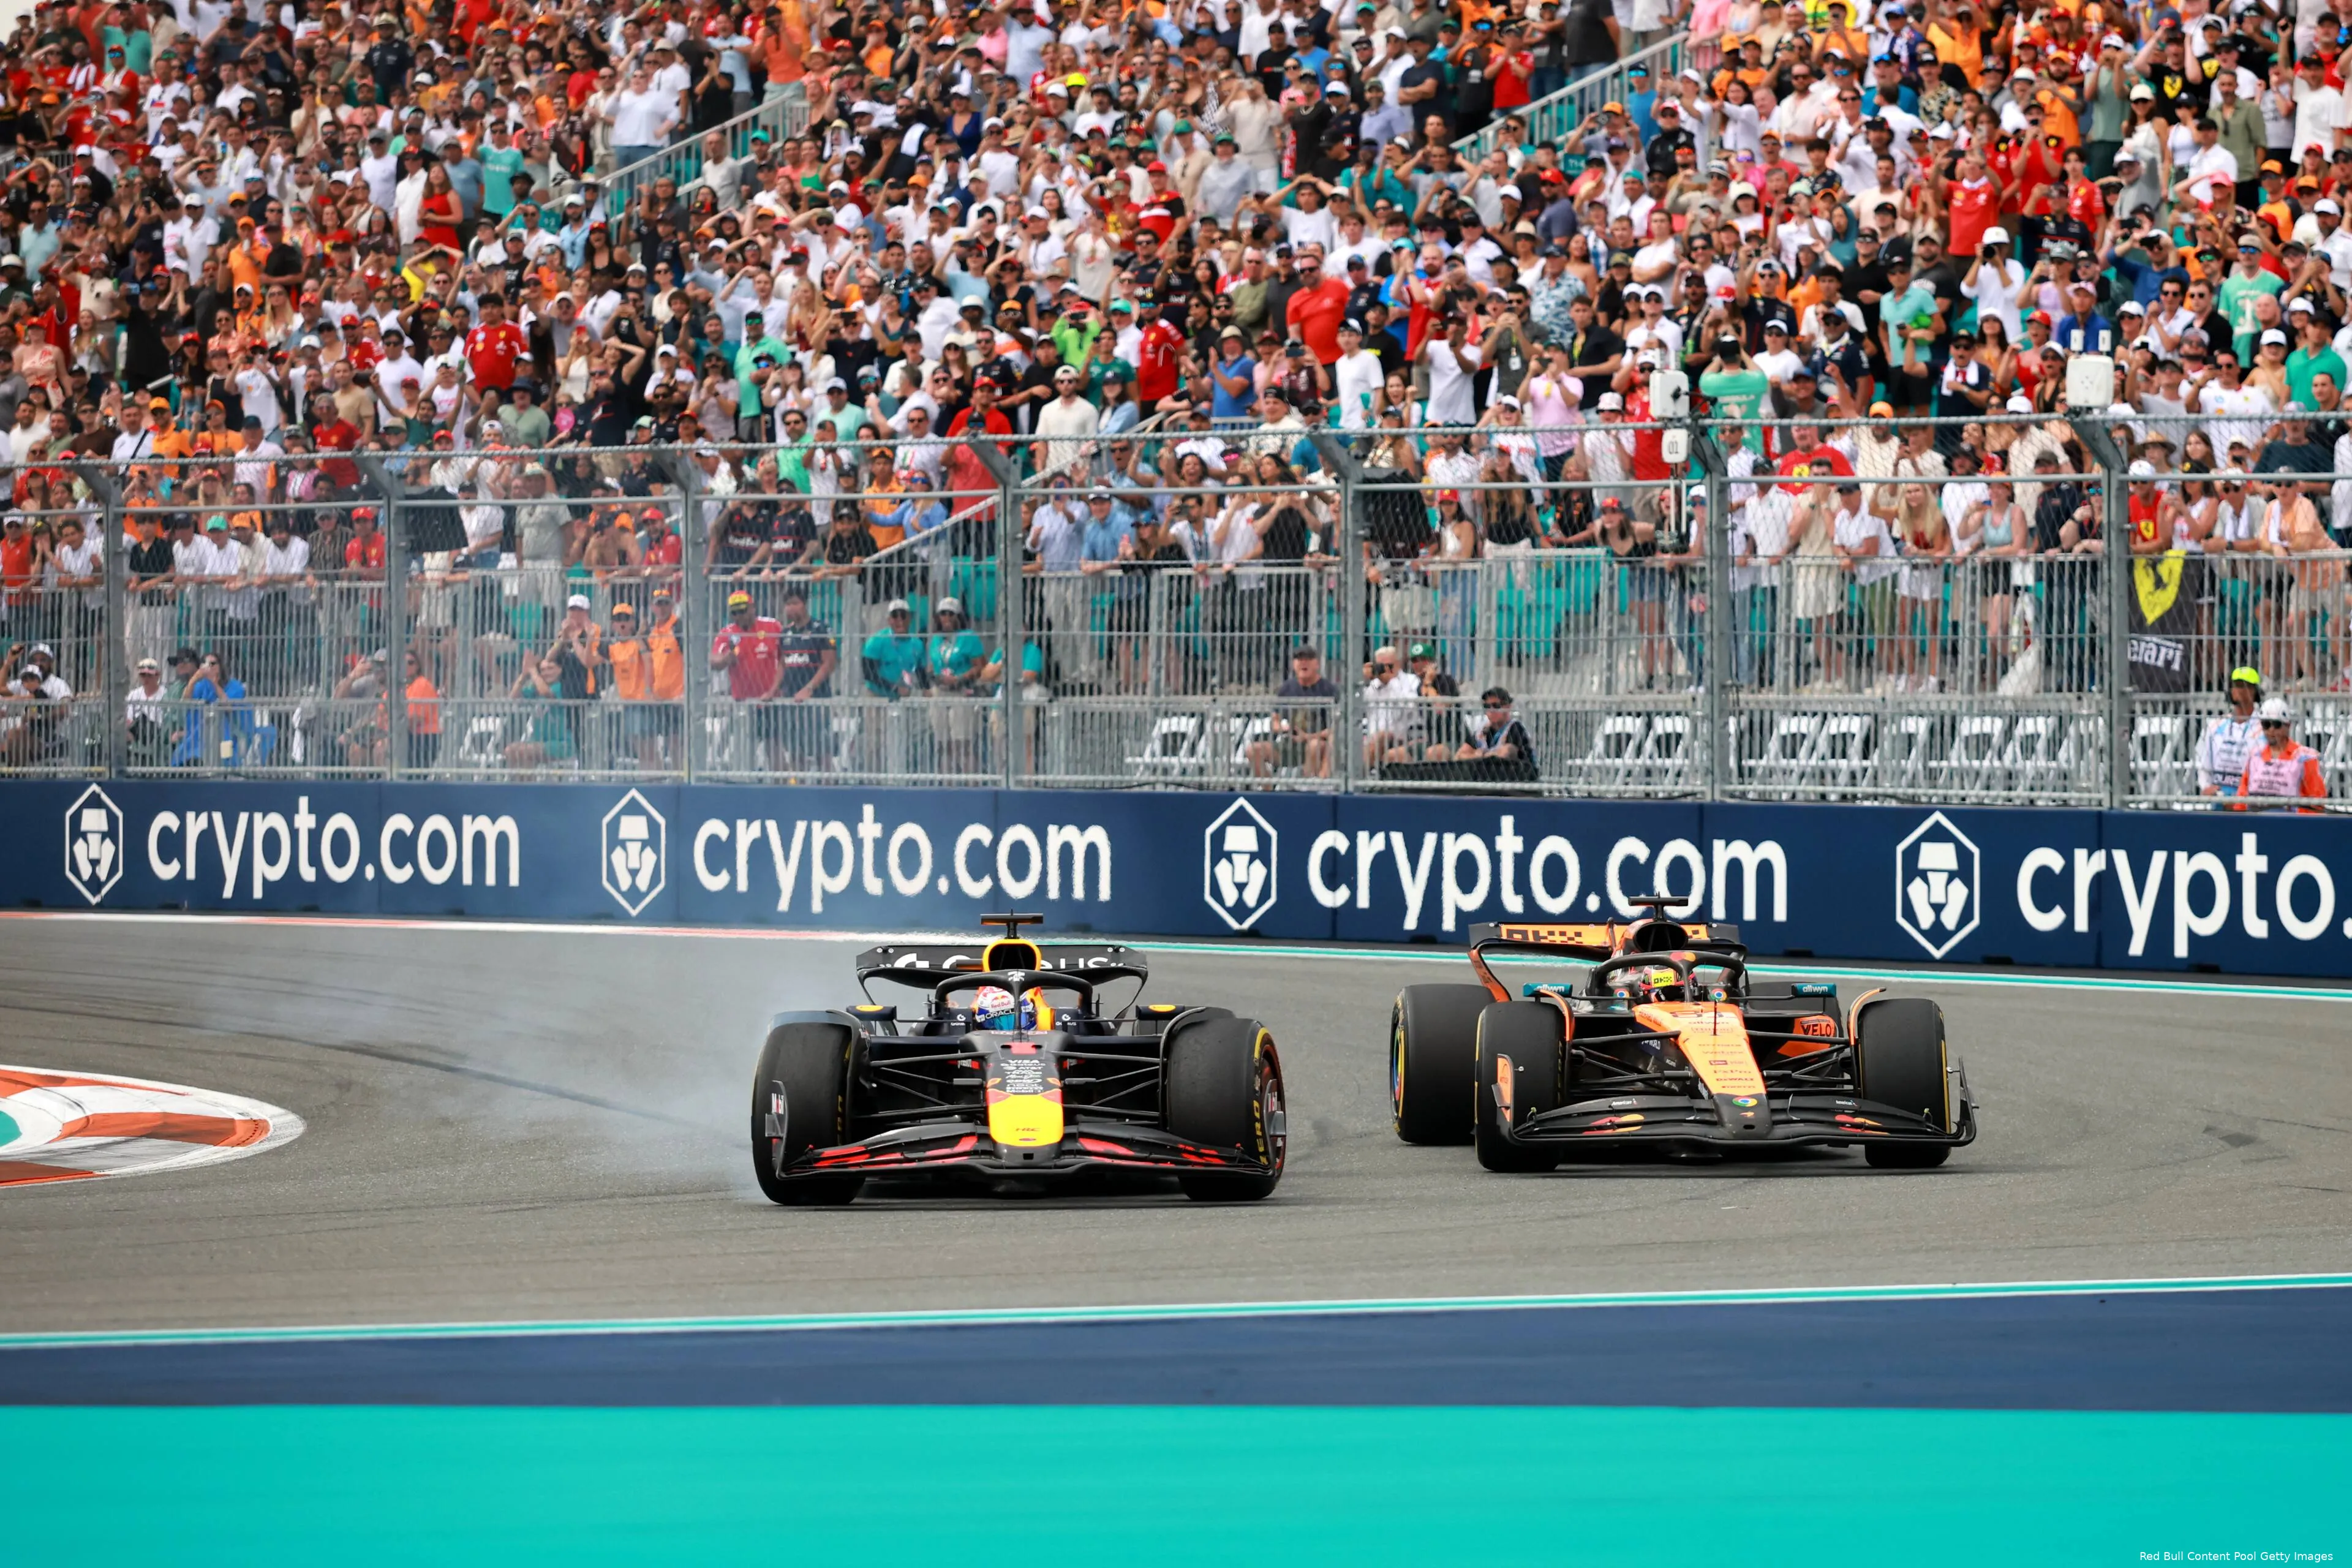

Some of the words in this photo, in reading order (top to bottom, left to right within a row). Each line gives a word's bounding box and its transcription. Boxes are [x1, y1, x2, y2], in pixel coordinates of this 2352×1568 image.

[1668, 440, 1679, 454] 01
[148, 796, 519, 899] crypto.com
[694, 804, 1111, 914] crypto.com
[1308, 815, 1787, 932] crypto.com
[1803, 982, 1828, 994] allwyn
[986, 1009, 1016, 1019] ORACL
[1801, 1023, 1832, 1037] VELO
[1253, 1099, 1268, 1166] ZERO
